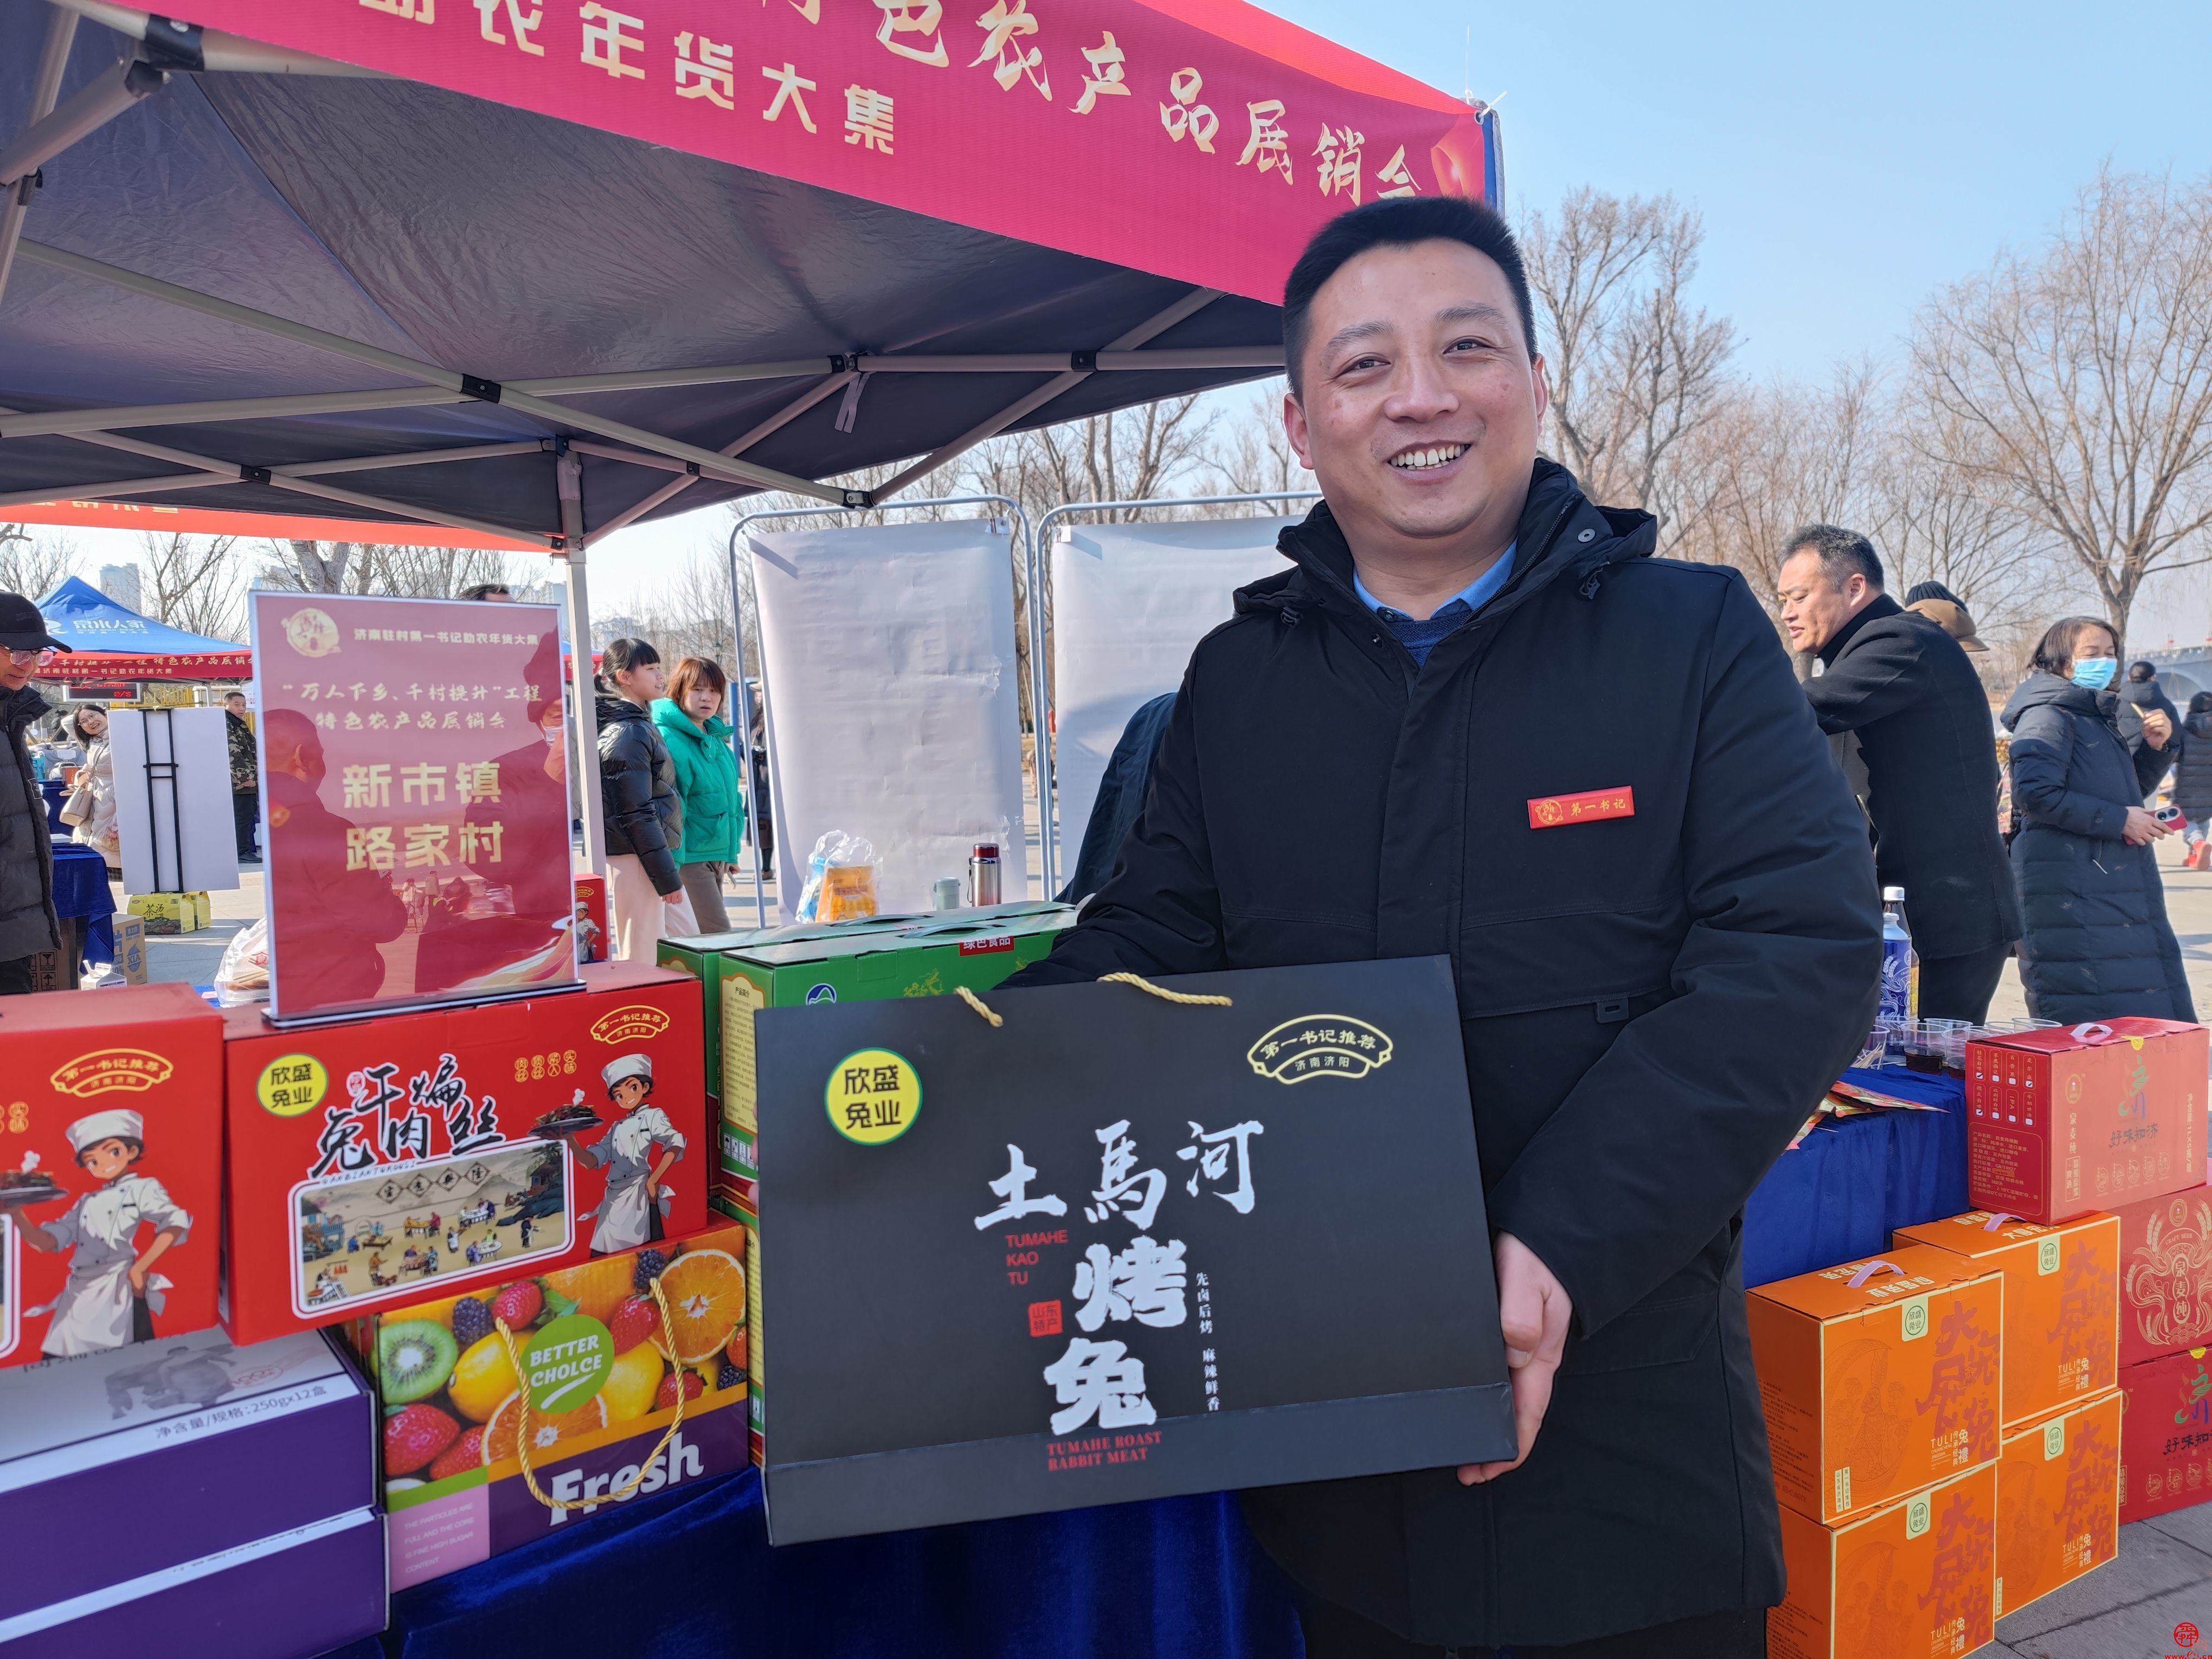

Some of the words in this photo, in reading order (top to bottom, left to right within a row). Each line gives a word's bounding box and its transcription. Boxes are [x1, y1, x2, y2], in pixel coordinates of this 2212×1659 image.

[359, 0, 893, 155] 农年货大集
[761, 0, 1421, 205] 色农产品展销会
[354, 628, 538, 646] 济南驻村第一书记助农年货大集
[315, 711, 506, 730] 特色农产品展销会
[342, 761, 503, 809] 新市镇
[1571, 798, 1626, 816] 第一书记
[346, 821, 504, 871] 路家村
[598, 1013, 661, 1032] 第一书记推荐
[1260, 1030, 1376, 1059] 第一书记推荐
[62, 1058, 159, 1082] 第一书记推荐
[1295, 1056, 1350, 1071] 济南济阳
[271, 1064, 311, 1086] 欣盛
[844, 1064, 900, 1095] 欣盛
[272, 1086, 312, 1108] 兔业
[846, 1099, 902, 1129] 兔业
[1005, 1229, 1069, 1248] TUMAHE
[1006, 1251, 1039, 1267] KAO
[1007, 1271, 1028, 1285] TU
[2175, 1261, 2187, 1319] 泉麦纯
[1909, 1310, 1921, 1321] 欣盛
[1909, 1320, 1921, 1330] 兔业
[1043, 1234, 1187, 1436] 烤兔
[530, 1334, 600, 1367] BETTER
[2058, 1361, 2076, 1374] TULI
[1046, 1437, 1111, 1456] TUMAHE
[1115, 1431, 1162, 1448] ROAST
[1931, 1433, 1952, 1449] TULI
[2163, 1429, 2212, 1456] 好味知
[1049, 1452, 1103, 1471] RABBIT
[1107, 1447, 1148, 1464] MEAT
[549, 1432, 704, 1526] Fresh
[2062, 1538, 2079, 1553] TULI
[1931, 1623, 1951, 1641] TULI
